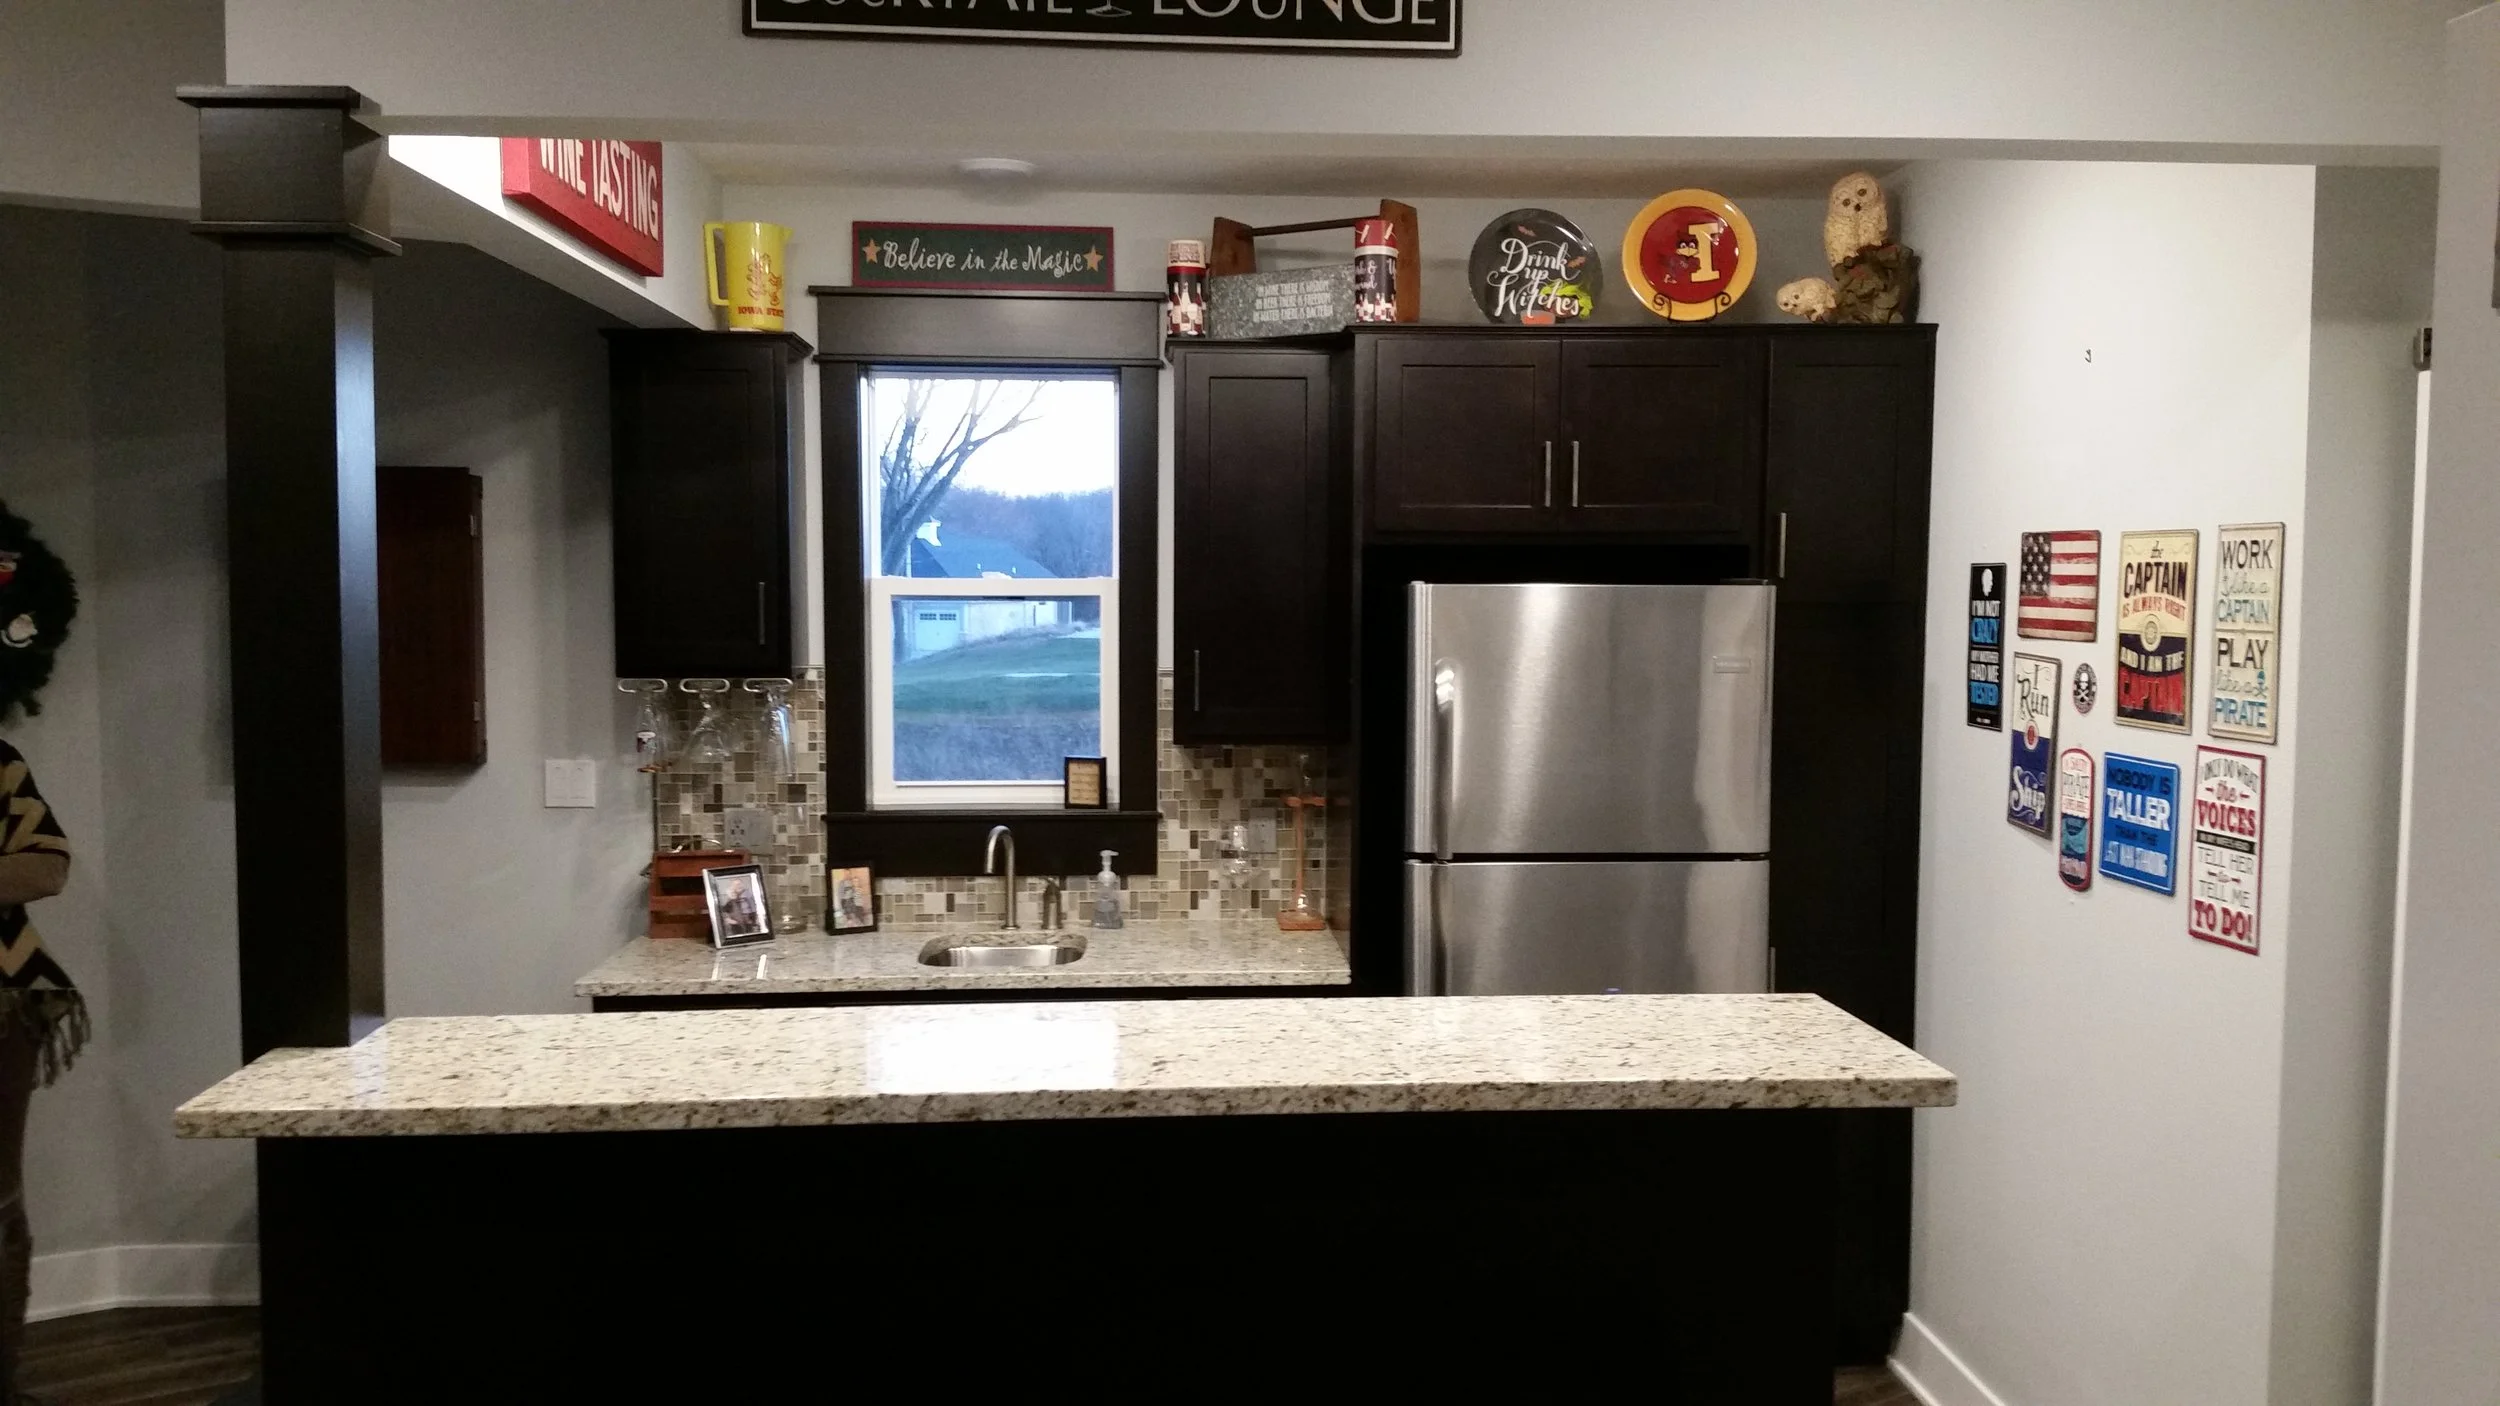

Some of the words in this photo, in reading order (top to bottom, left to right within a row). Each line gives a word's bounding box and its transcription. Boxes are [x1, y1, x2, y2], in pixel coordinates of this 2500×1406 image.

[883, 237, 955, 271] Believe
[960, 248, 985, 271] in
[989, 248, 1018, 272] the
[1022, 244, 1083, 278] Magic
[1501, 238, 1580, 281] Drink
[1487, 271, 1580, 318] Witches
[738, 306, 763, 315] IOWA
[2221, 539, 2274, 569] WORK
[2124, 561, 2188, 601] CAPTAIN
[1986, 600, 2000, 617] NOT
[2122, 603, 2130, 618] IS
[2132, 596, 2162, 614] ALWAYS
[2165, 598, 2186, 621] RIGHT
[2218, 599, 2270, 624] CAPTAIN
[2120, 646, 2139, 668] AND
[2140, 654, 2146, 671] I
[2147, 655, 2163, 672] AM
[2165, 651, 2184, 671] THE
[2217, 637, 2269, 669] PLAY
[1970, 663, 1986, 681] HAD
[1986, 665, 1999, 682] ME
[2016, 674, 2049, 720] Run
[2214, 697, 2267, 728] PIRATE
[2010, 766, 2046, 820] Ship
[2107, 766, 2156, 791] NOBODY
[2158, 775, 2171, 796] IS
[2217, 780, 2237, 803] the
[2106, 787, 2171, 831] TALLER
[2197, 799, 2256, 838] VOICES
[2115, 824, 2137, 841] THAN
[2141, 830, 2158, 847] THE
[2198, 846, 2226, 868] TELL
[2229, 853, 2254, 875] HER
[2199, 879, 2228, 902] TELL
[2232, 888, 2250, 909] ME
[2194, 899, 2217, 931] TO
[2221, 906, 2253, 943] DO!
